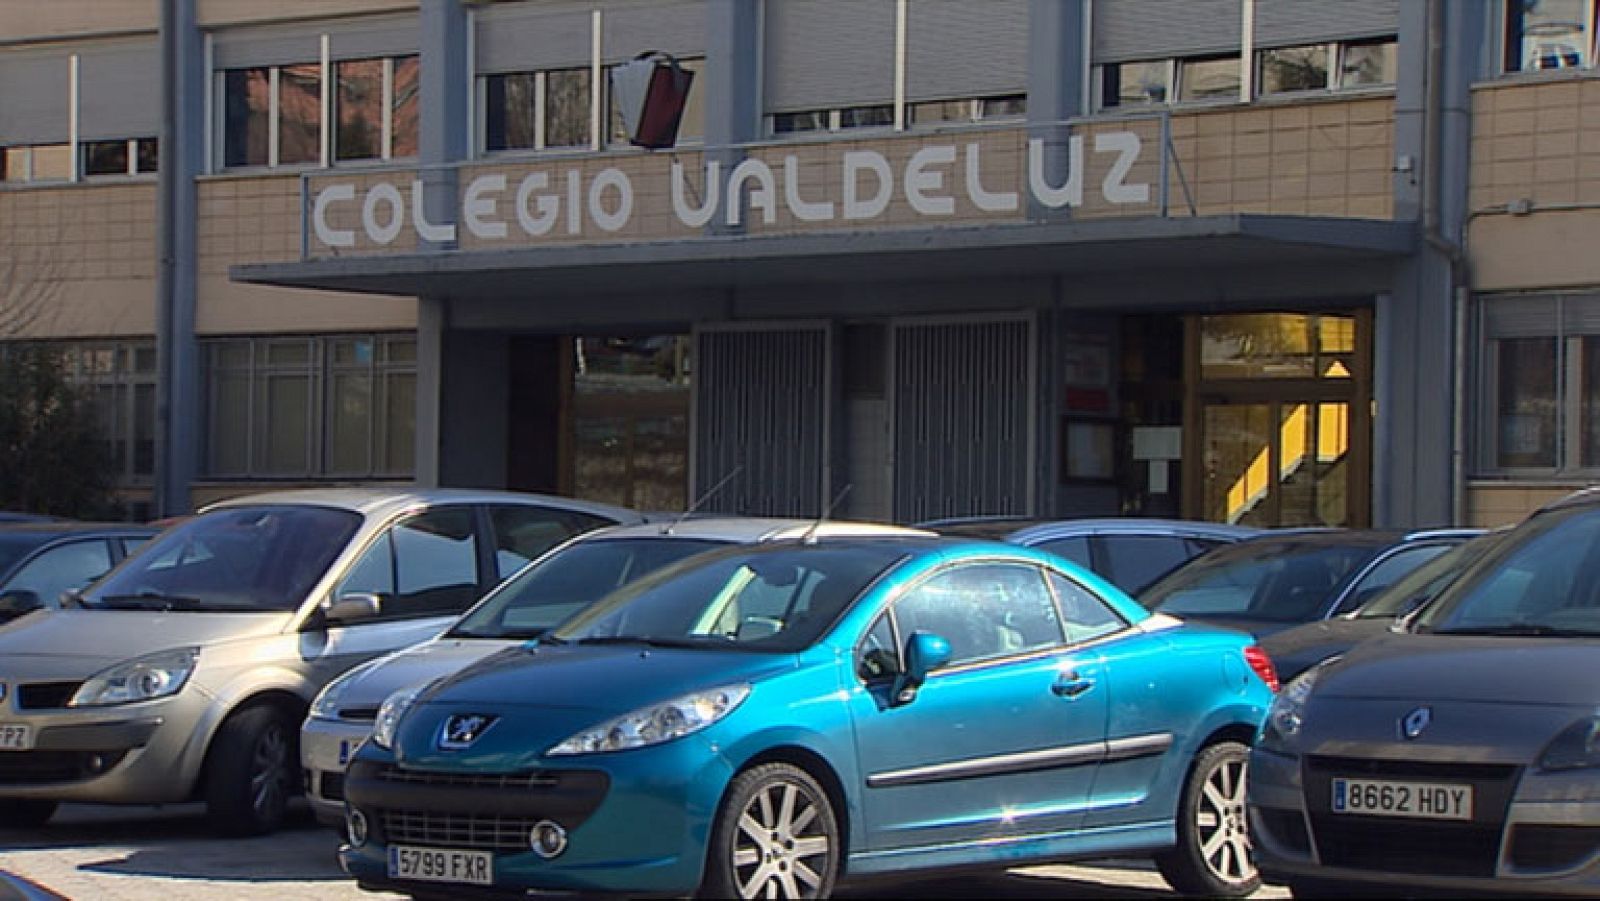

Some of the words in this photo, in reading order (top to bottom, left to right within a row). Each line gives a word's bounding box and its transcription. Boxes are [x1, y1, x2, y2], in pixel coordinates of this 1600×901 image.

[313, 168, 634, 247] COLEGIO
[1350, 783, 1411, 812] 8662
[1418, 787, 1465, 815] HDY
[400, 849, 446, 877] 5799
[451, 854, 487, 881] FXR
